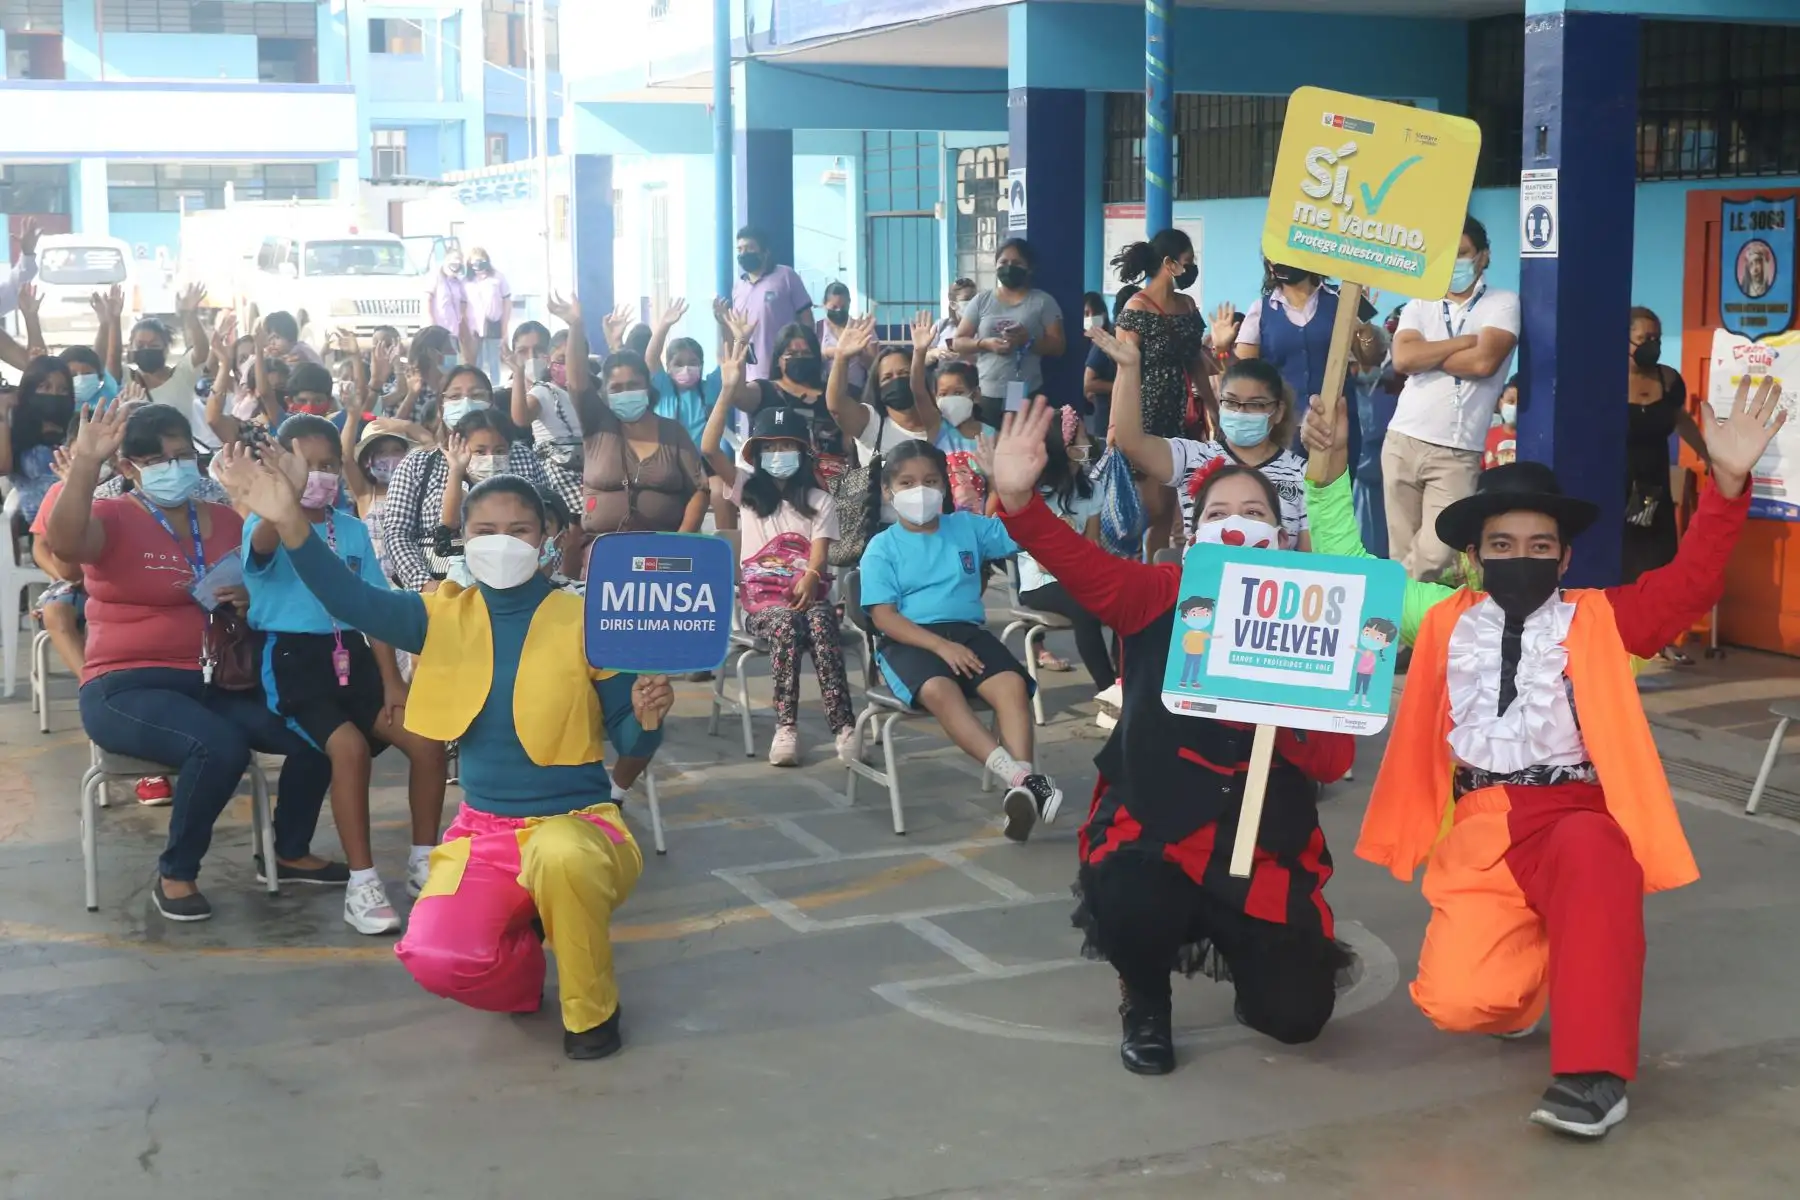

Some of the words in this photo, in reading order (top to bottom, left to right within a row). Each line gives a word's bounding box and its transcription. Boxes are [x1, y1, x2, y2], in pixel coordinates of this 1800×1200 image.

[1300, 140, 1358, 212] Sí,
[1292, 201, 1332, 229] me
[1338, 211, 1426, 252] vacuno.
[1293, 230, 1338, 253] Protege
[1338, 242, 1384, 264] nuestra
[1384, 251, 1418, 272] niñez
[601, 581, 716, 613] MINSA
[1241, 576, 1346, 626] TODOS
[600, 618, 634, 631] DIRIS
[637, 619, 670, 631] LIMA
[673, 619, 716, 632] NORTE
[1234, 618, 1339, 658] VUELVEN
